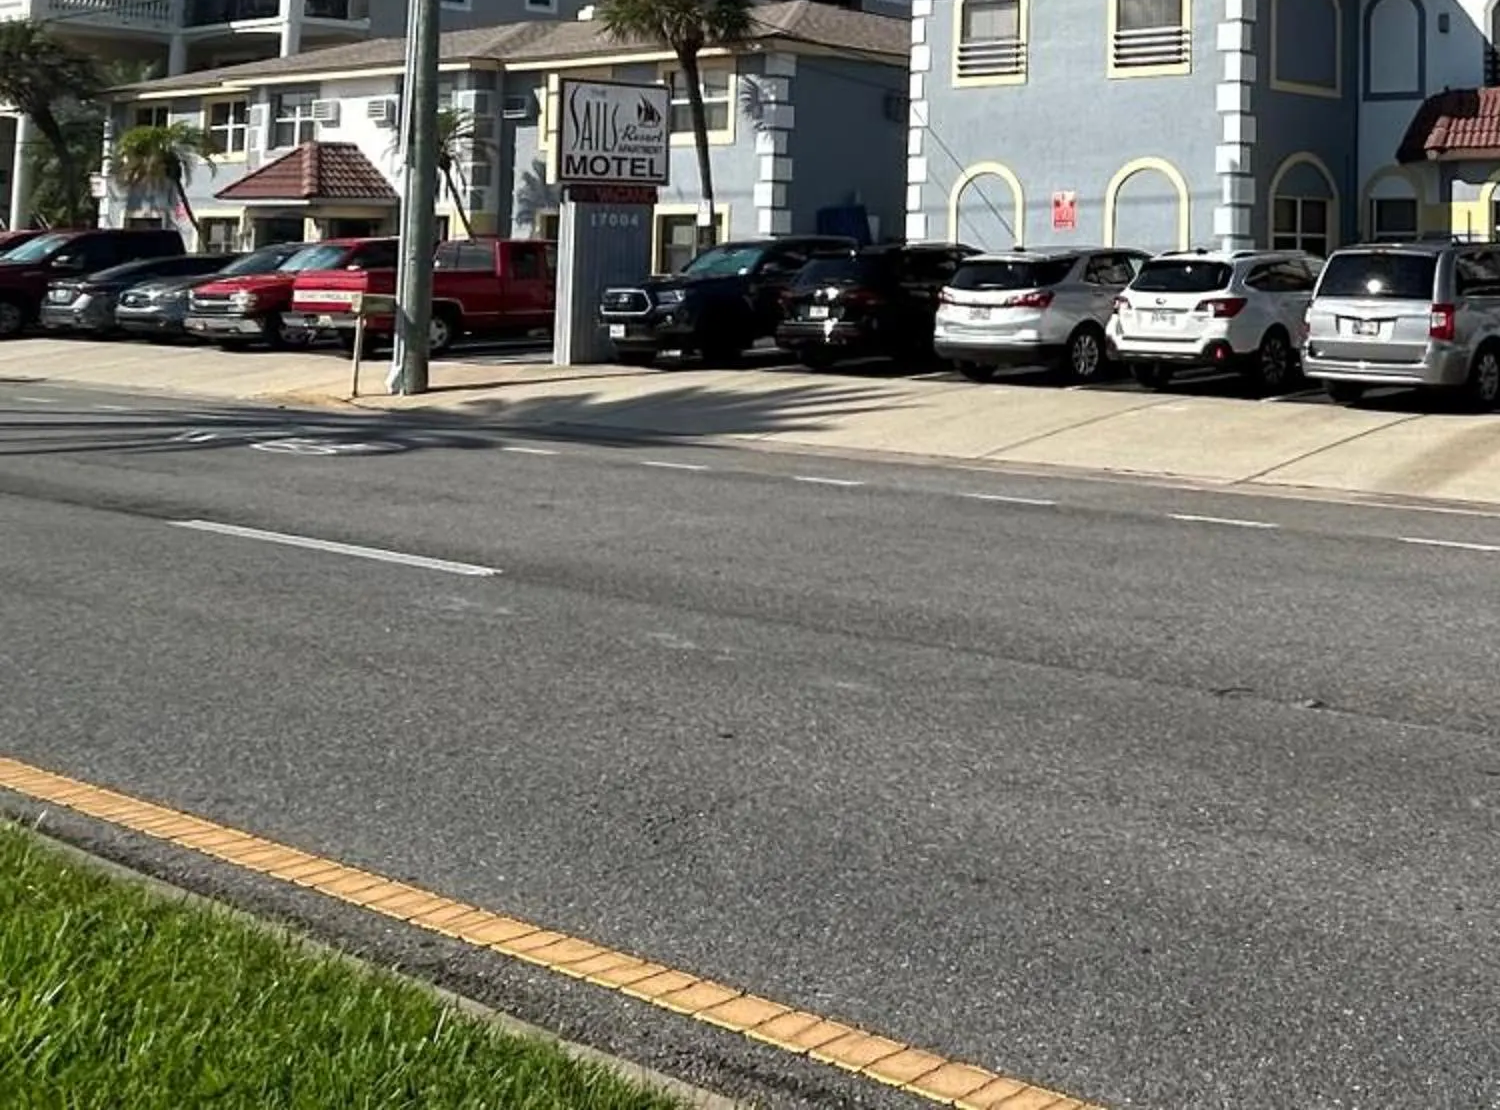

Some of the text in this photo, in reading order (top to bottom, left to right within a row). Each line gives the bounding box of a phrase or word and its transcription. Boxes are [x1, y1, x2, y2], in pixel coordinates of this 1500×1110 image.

[569, 85, 620, 151] SAILS
[565, 155, 664, 178] MOTEL
[591, 213, 639, 227] 17004
